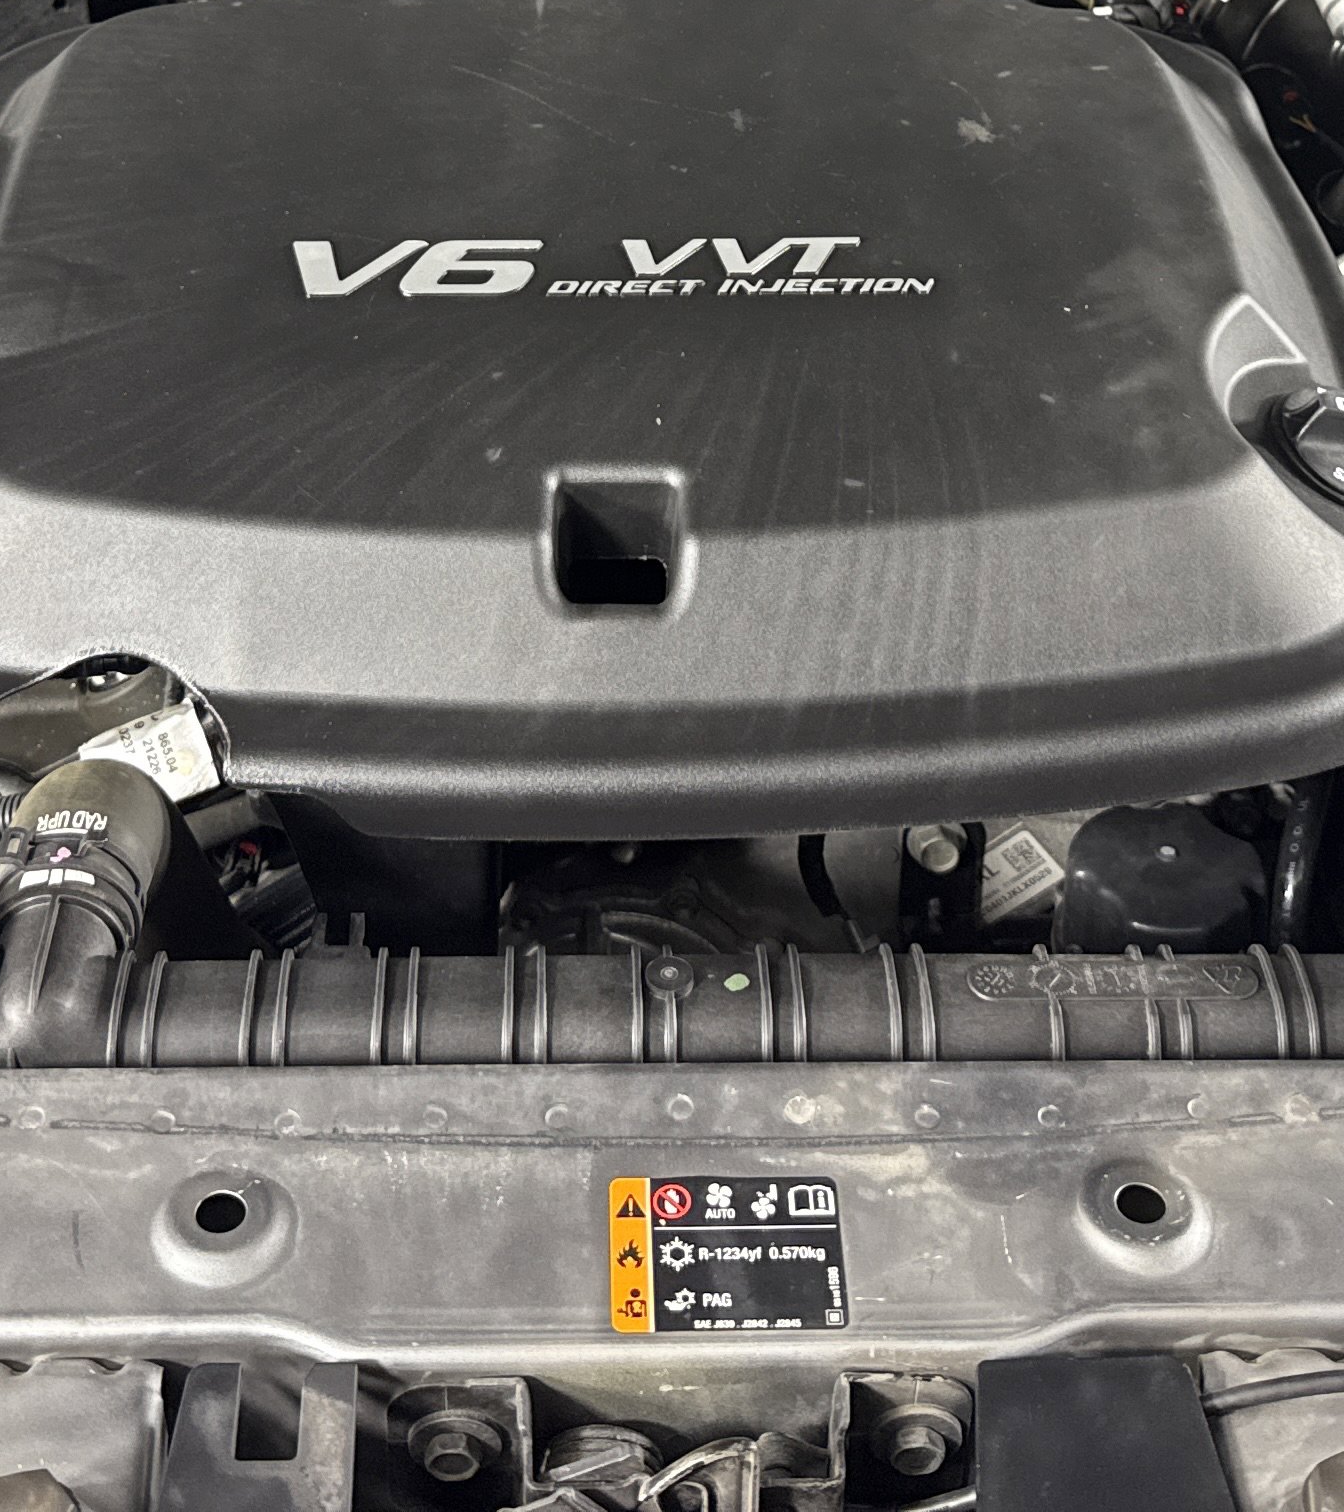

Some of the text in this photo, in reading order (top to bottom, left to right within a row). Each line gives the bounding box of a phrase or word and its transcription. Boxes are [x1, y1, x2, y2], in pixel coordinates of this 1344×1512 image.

[621, 236, 861, 276] VVT
[292, 239, 544, 298] V6
[546, 277, 935, 297] DIRECT INJECTION
[142, 738, 162, 775] 21226
[157, 732, 179, 774] 865.04
[36, 810, 108, 831] RAD UPR
[705, 1208, 736, 1219] AUTO
[698, 1245, 826, 1263] R-1234yf 0.570kg
[702, 1292, 733, 1307] PAG
[694, 1319, 712, 1329] SAE
